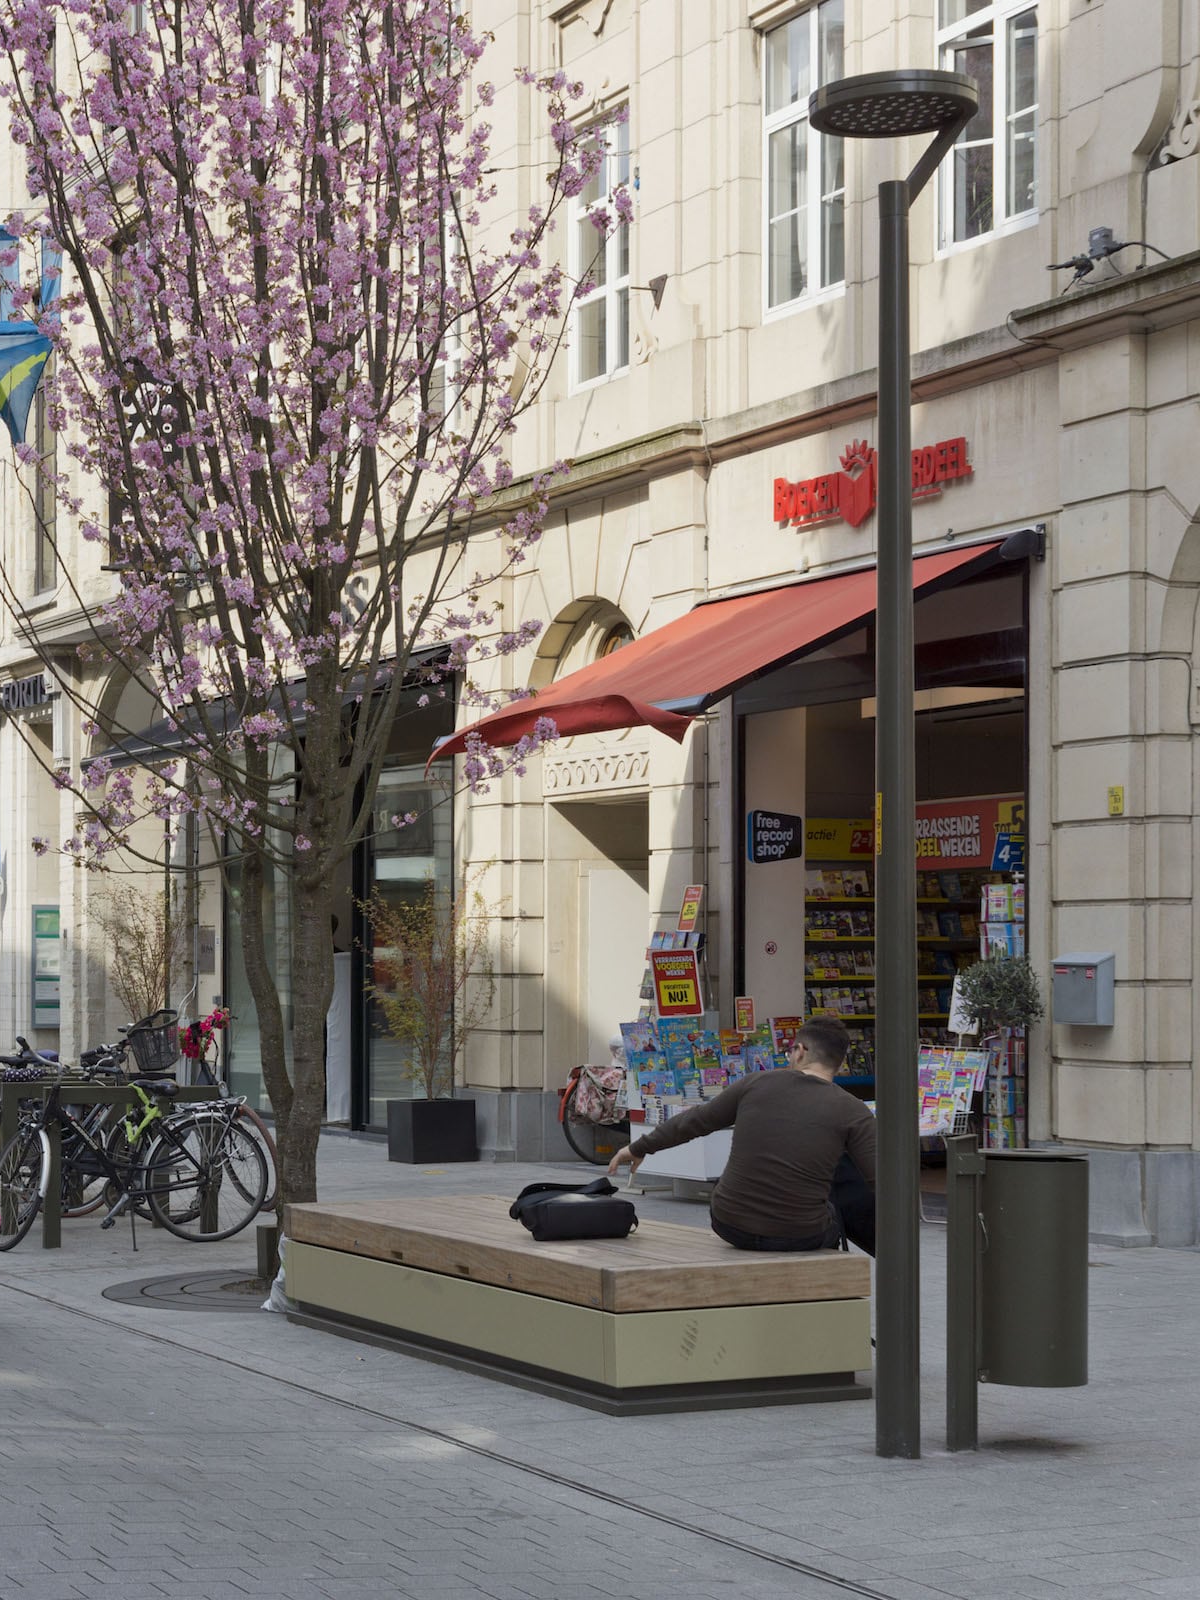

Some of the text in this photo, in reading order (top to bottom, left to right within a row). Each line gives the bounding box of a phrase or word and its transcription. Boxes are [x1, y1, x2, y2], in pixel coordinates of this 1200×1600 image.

[774, 472, 840, 522] BOEKEN
[756, 813, 780, 828] free
[756, 828, 793, 841] record
[756, 841, 786, 858] shop
[656, 962, 694, 971] VOORDEEL
[668, 990, 689, 1003] NU!
